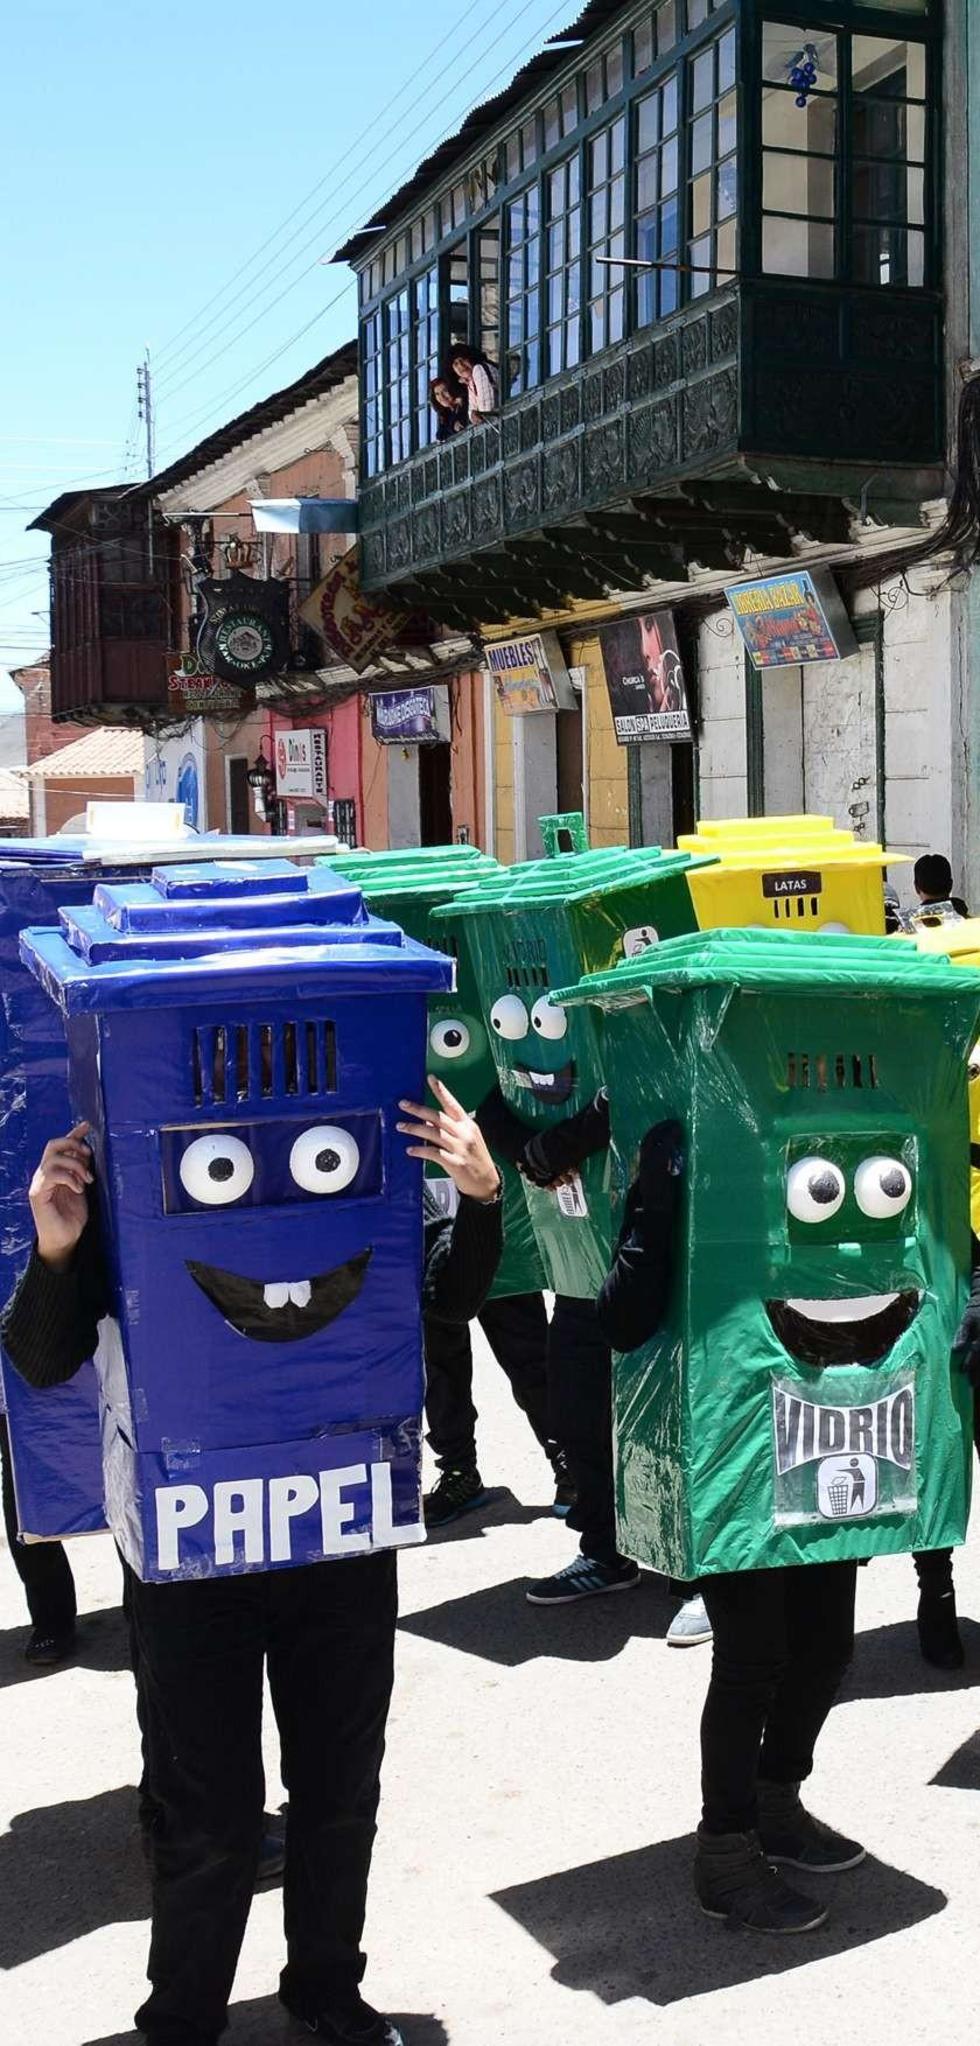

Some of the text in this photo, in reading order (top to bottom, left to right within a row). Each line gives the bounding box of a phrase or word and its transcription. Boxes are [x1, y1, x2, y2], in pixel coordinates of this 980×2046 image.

[767, 582, 805, 610] BAZAR
[488, 642, 534, 673] MUEBLES
[616, 713, 688, 733] SALON SPA PELUQUERIA
[313, 733, 324, 794] RESTAURANTE
[774, 880, 807, 892] LATAS
[775, 1388, 914, 1474] VIDRIO
[155, 1462, 427, 1570] PAPEL
